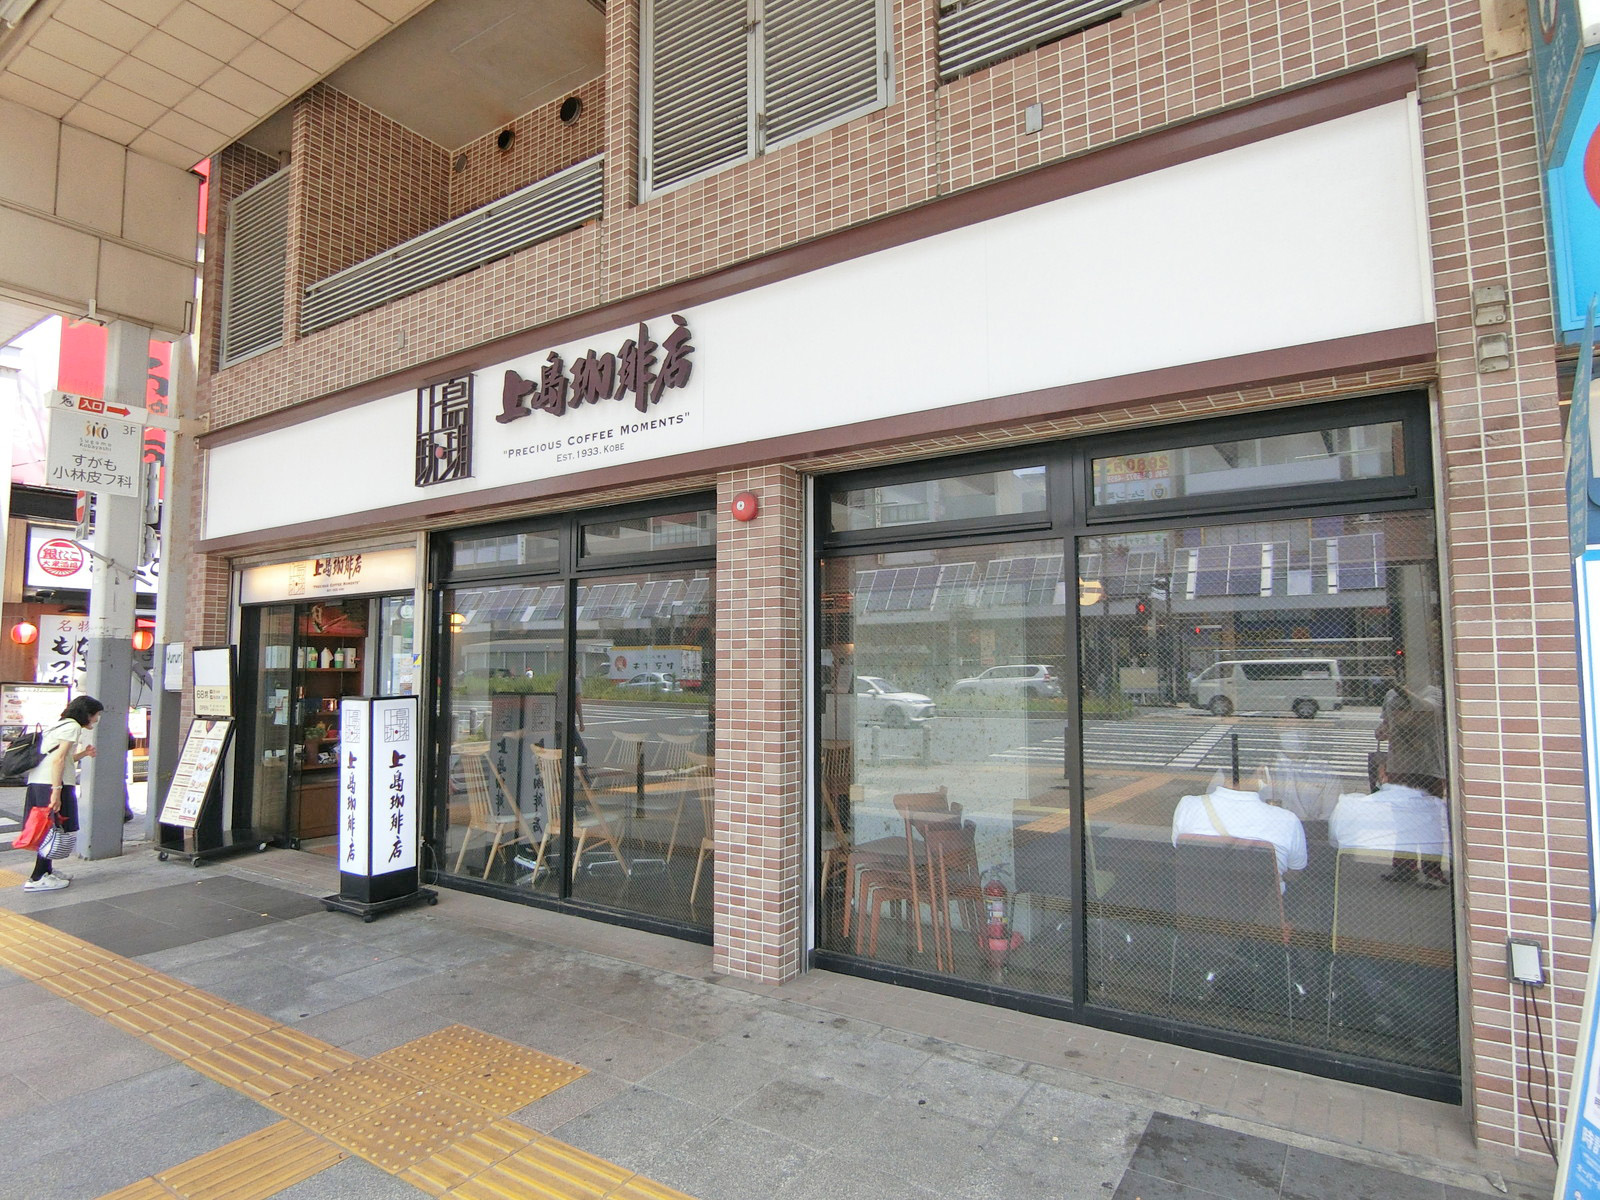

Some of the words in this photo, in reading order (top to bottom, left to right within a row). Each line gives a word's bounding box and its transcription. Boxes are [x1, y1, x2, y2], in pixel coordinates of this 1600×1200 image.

[495, 314, 696, 424] 上島珈琲店
[81, 399, 102, 411] 入口
[123, 425, 136, 436] 3F
[567, 429, 613, 446] COFFEE
[604, 443, 625, 454] KOBE
[72, 454, 117, 472] すがも
[53, 466, 132, 489] 小林皮フ科
[346, 750, 358, 863] 上島珈琲店
[388, 749, 406, 863] 上島珈琲店
